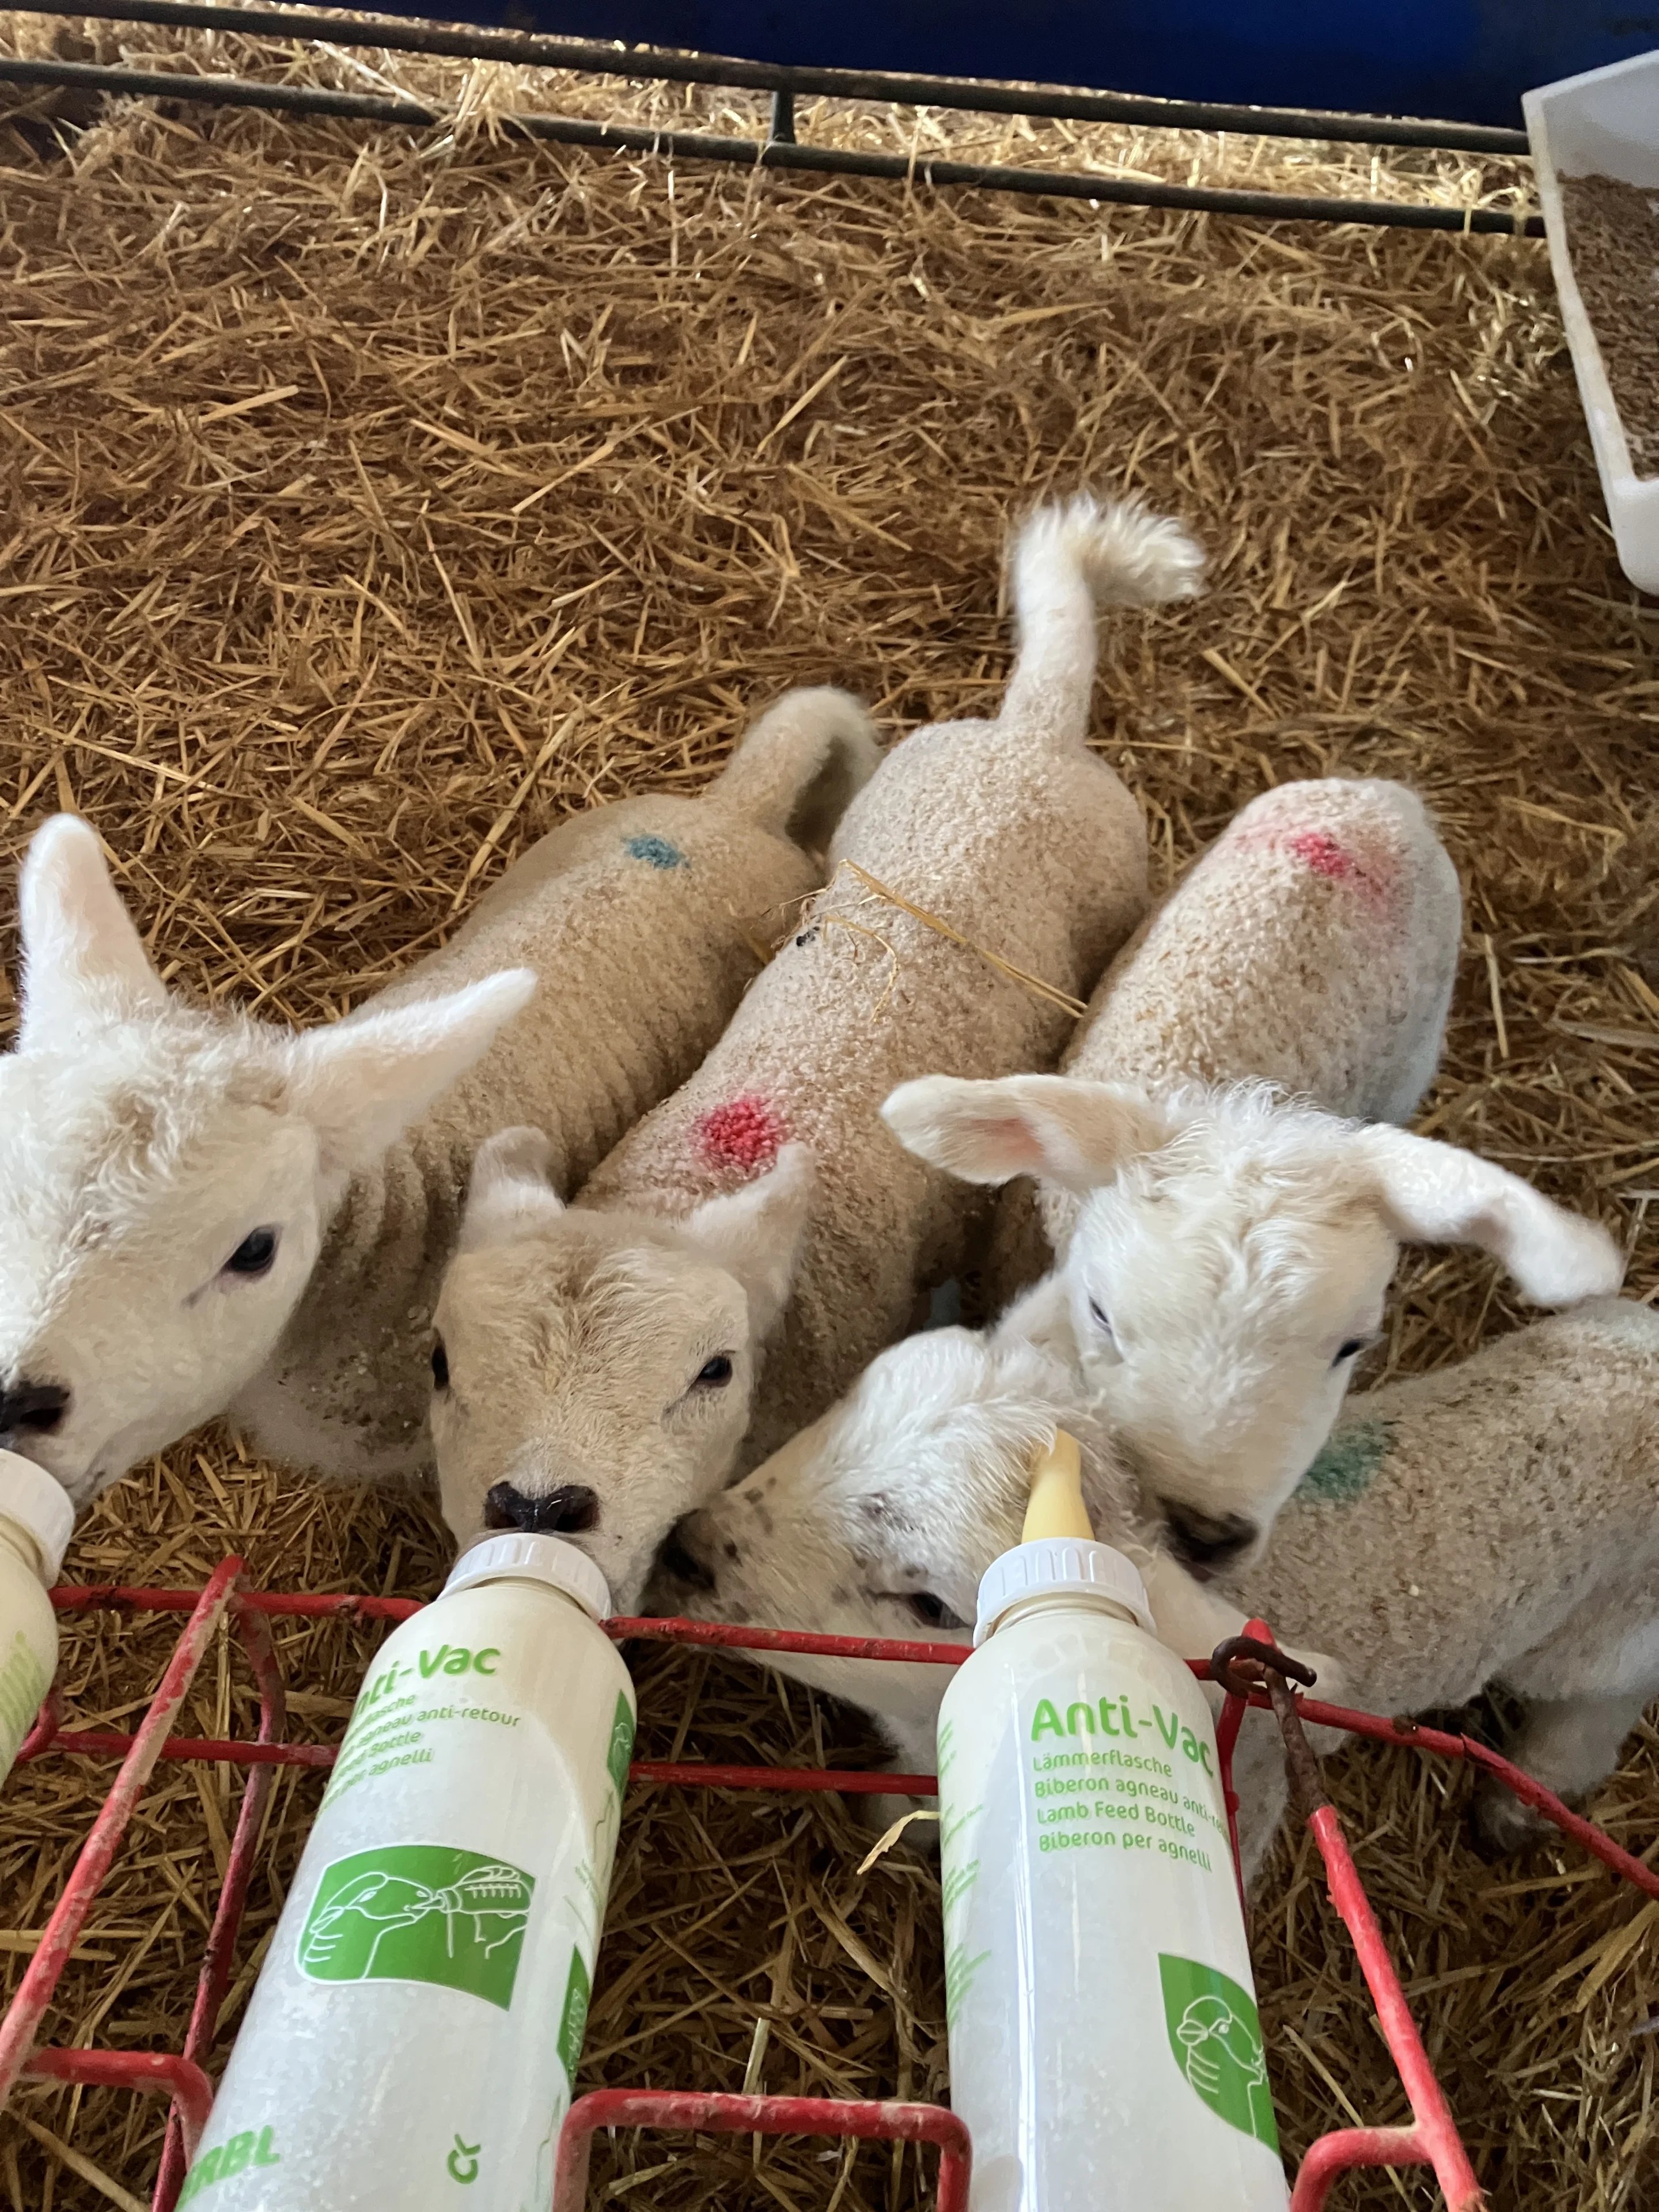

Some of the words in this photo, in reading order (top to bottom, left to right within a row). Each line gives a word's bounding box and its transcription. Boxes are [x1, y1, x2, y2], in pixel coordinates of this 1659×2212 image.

[354, 1644, 501, 1718] nti-Vac
[416, 1705, 521, 1728] anti-retour
[1031, 1695, 1214, 1777] Anti-Vac
[368, 1748, 433, 1776] agnelli
[1033, 1749, 1172, 1778] Lämmerflasche
[1035, 1776, 1109, 1797] Biberon
[1116, 1778, 1179, 1804] agneau
[1036, 1801, 1089, 1824] Lamb
[1094, 1801, 1139, 1820] Feed
[1145, 1805, 1196, 1838] Bottle
[1039, 1830, 1116, 1853] Biberon
[1122, 1832, 1153, 1850] per
[1158, 1838, 1213, 1873] agnelli
